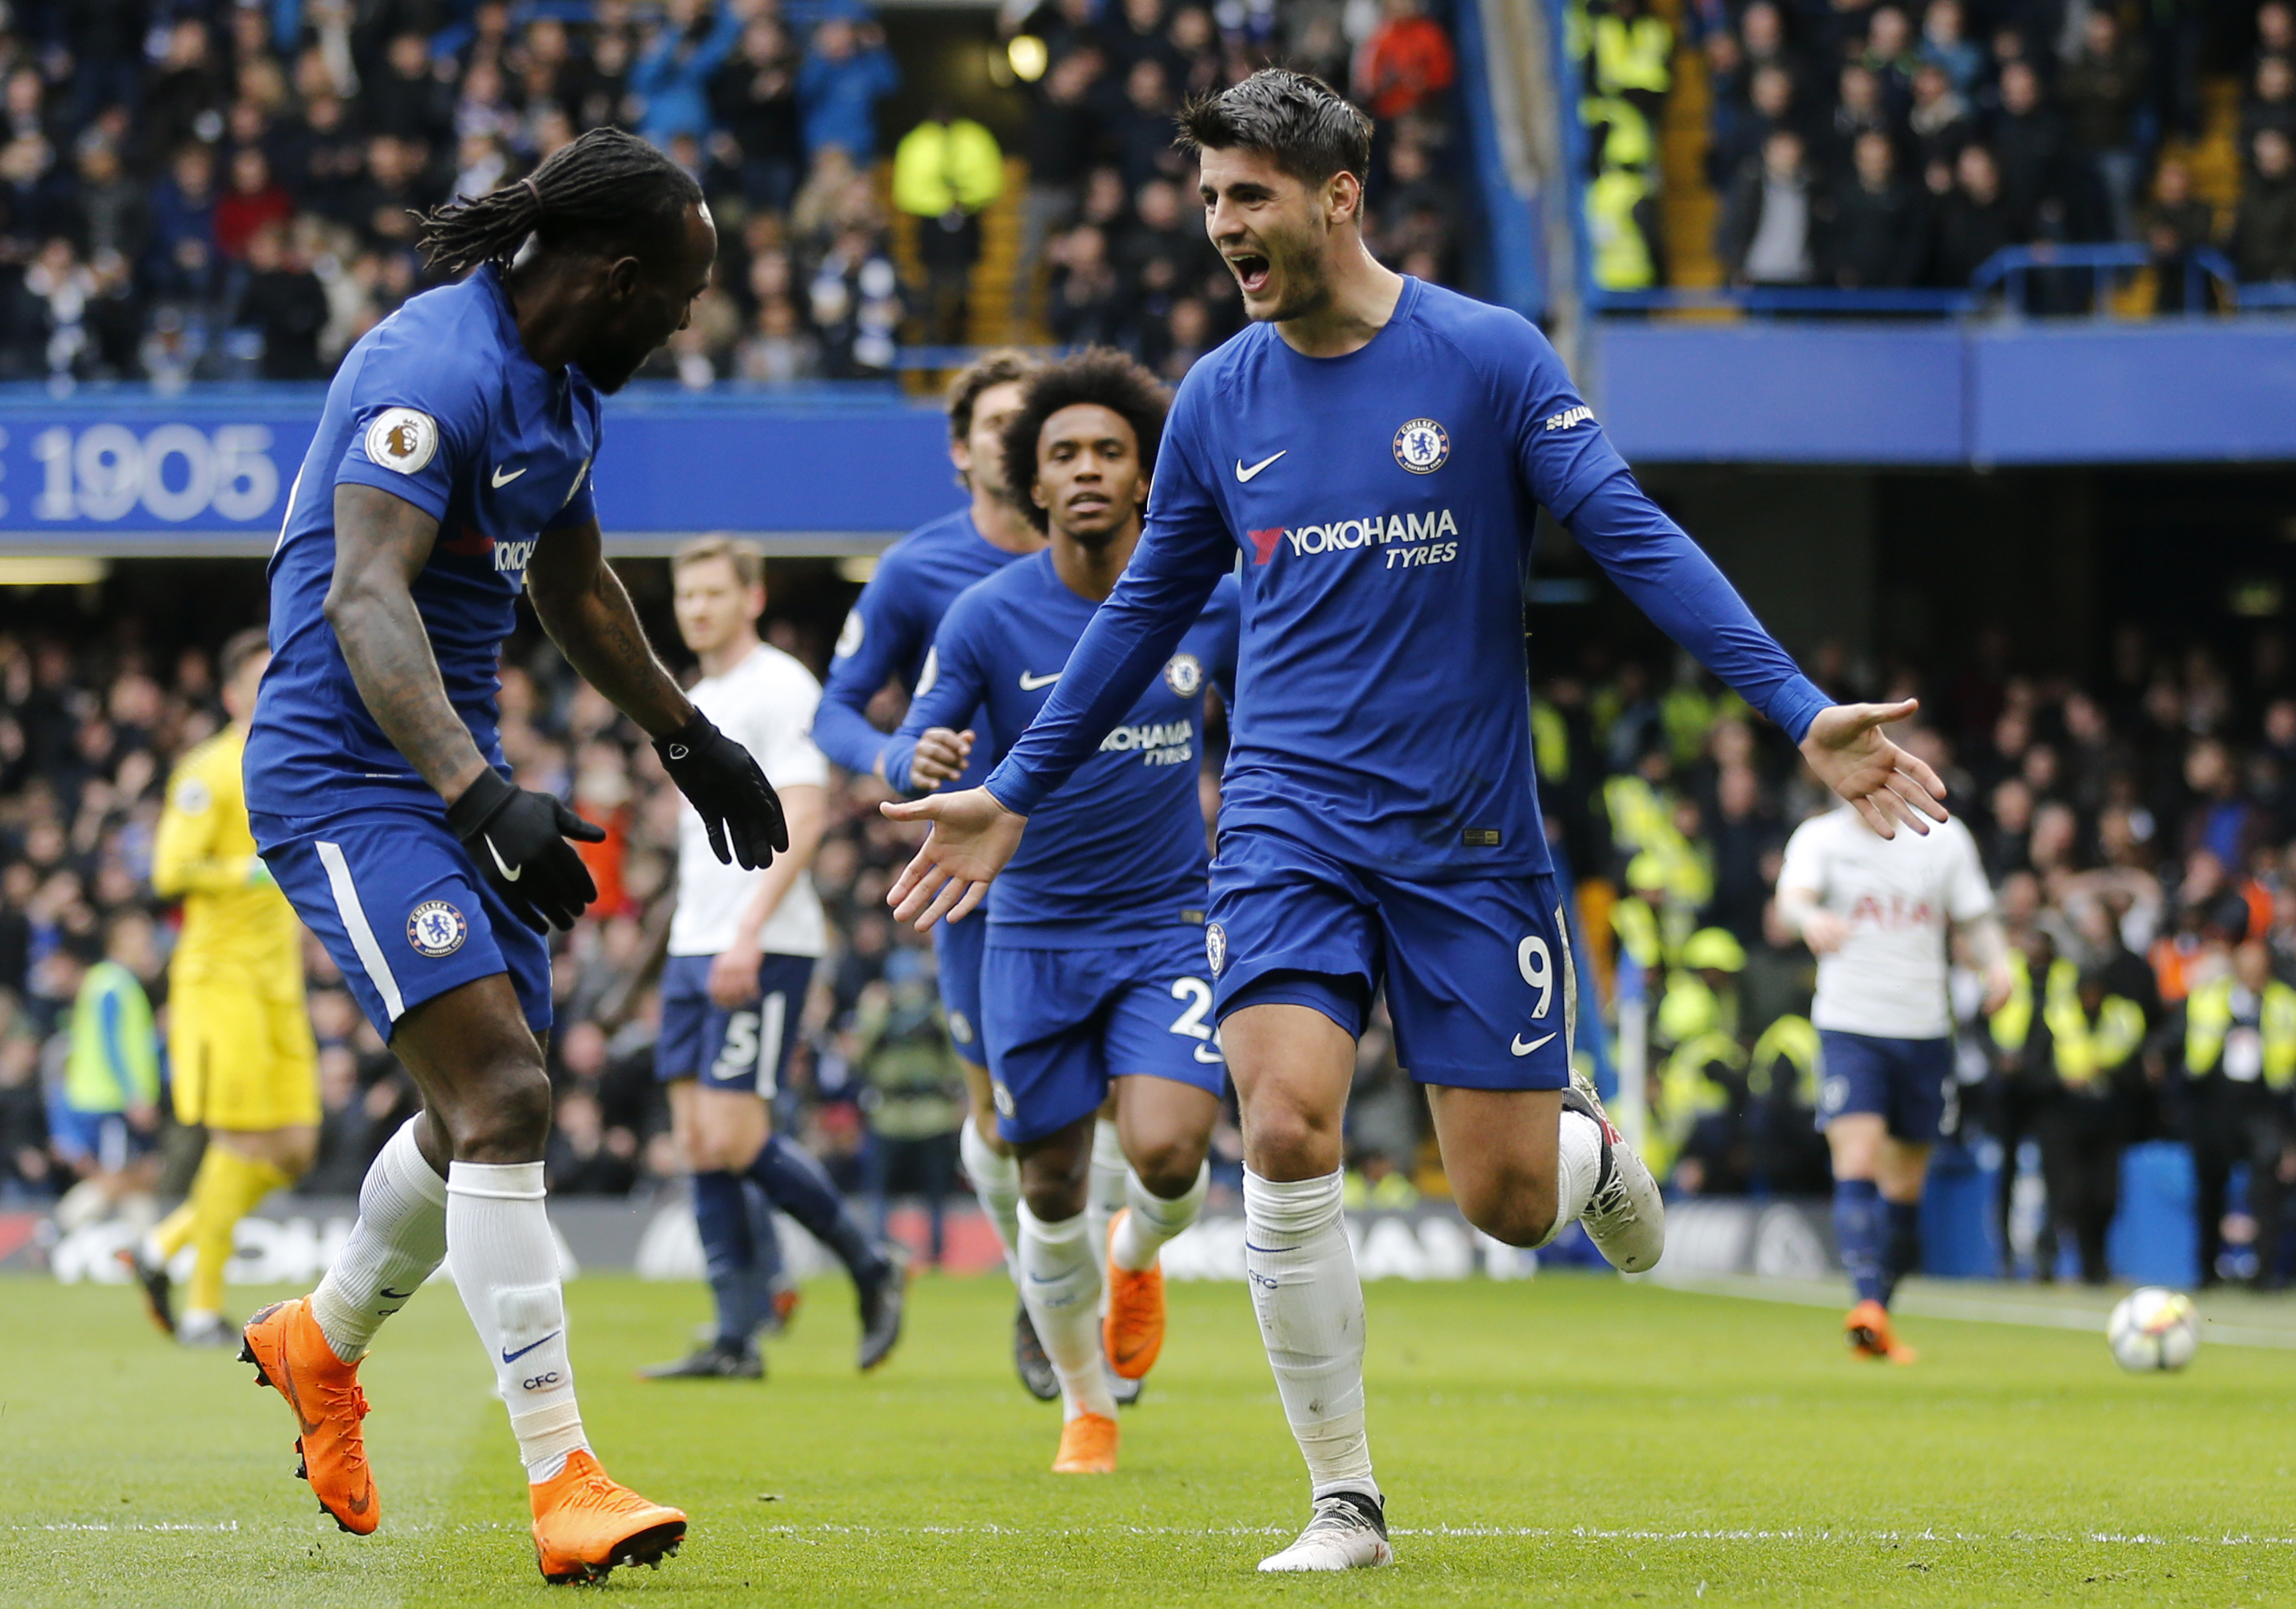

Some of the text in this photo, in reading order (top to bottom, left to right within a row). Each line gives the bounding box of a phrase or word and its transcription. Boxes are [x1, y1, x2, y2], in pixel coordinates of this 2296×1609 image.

[1401, 421, 1437, 434] CHELSEA
[32, 423, 279, 522] 1905
[1284, 508, 1459, 556] YOKOHAMA
[1386, 541, 1459, 569] TYRES
[411, 903, 449, 923] CHELSEA
[1518, 935, 1553, 1018] 9
[1169, 976, 1221, 1046] 2
[720, 1010, 760, 1069] 5
[1249, 1269, 1278, 1289] CFC
[523, 1372, 558, 1390] CFC
